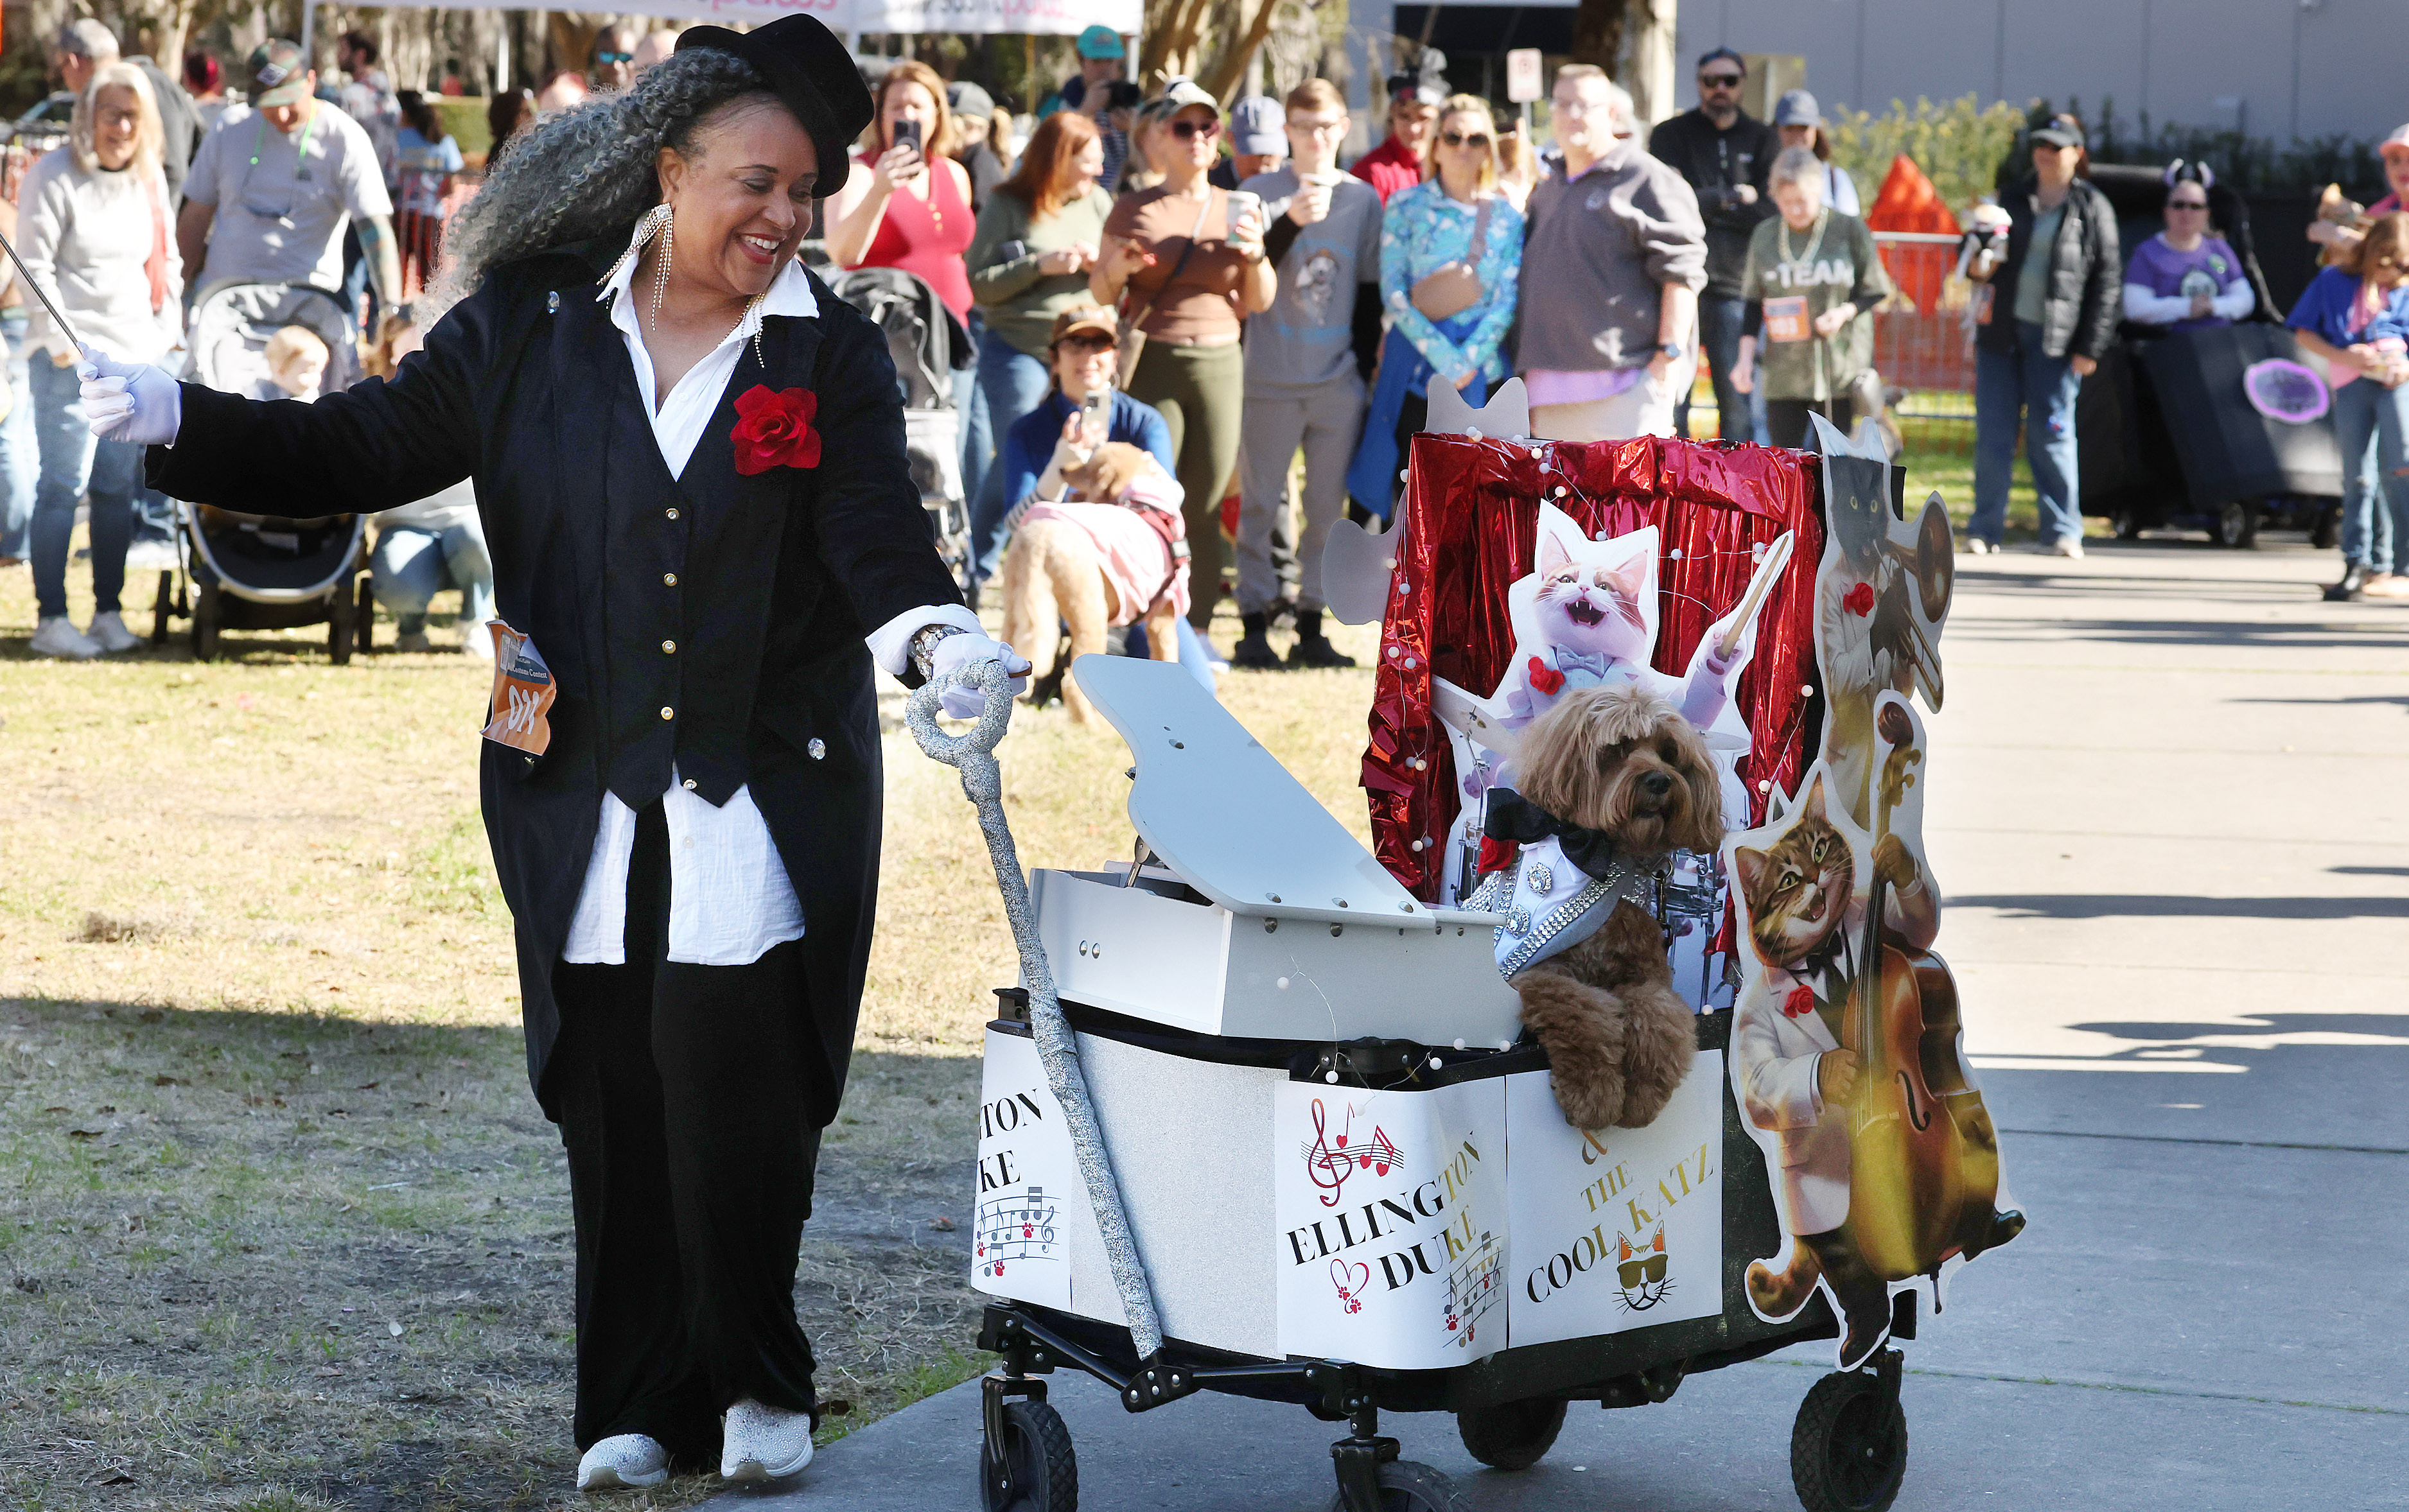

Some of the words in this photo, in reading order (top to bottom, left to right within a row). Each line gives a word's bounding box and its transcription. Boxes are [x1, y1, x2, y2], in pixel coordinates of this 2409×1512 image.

[529, 668, 548, 679] Contest
[979, 1088, 1042, 1140] TON
[977, 1151, 1020, 1193] KE
[1286, 1130, 1480, 1265] ELLINGTON
[1580, 1160, 1634, 1212] THE
[1377, 1205, 1476, 1291] DUKE
[1527, 1223, 1616, 1303] COOL
[1626, 1143, 1714, 1234] KATZ
